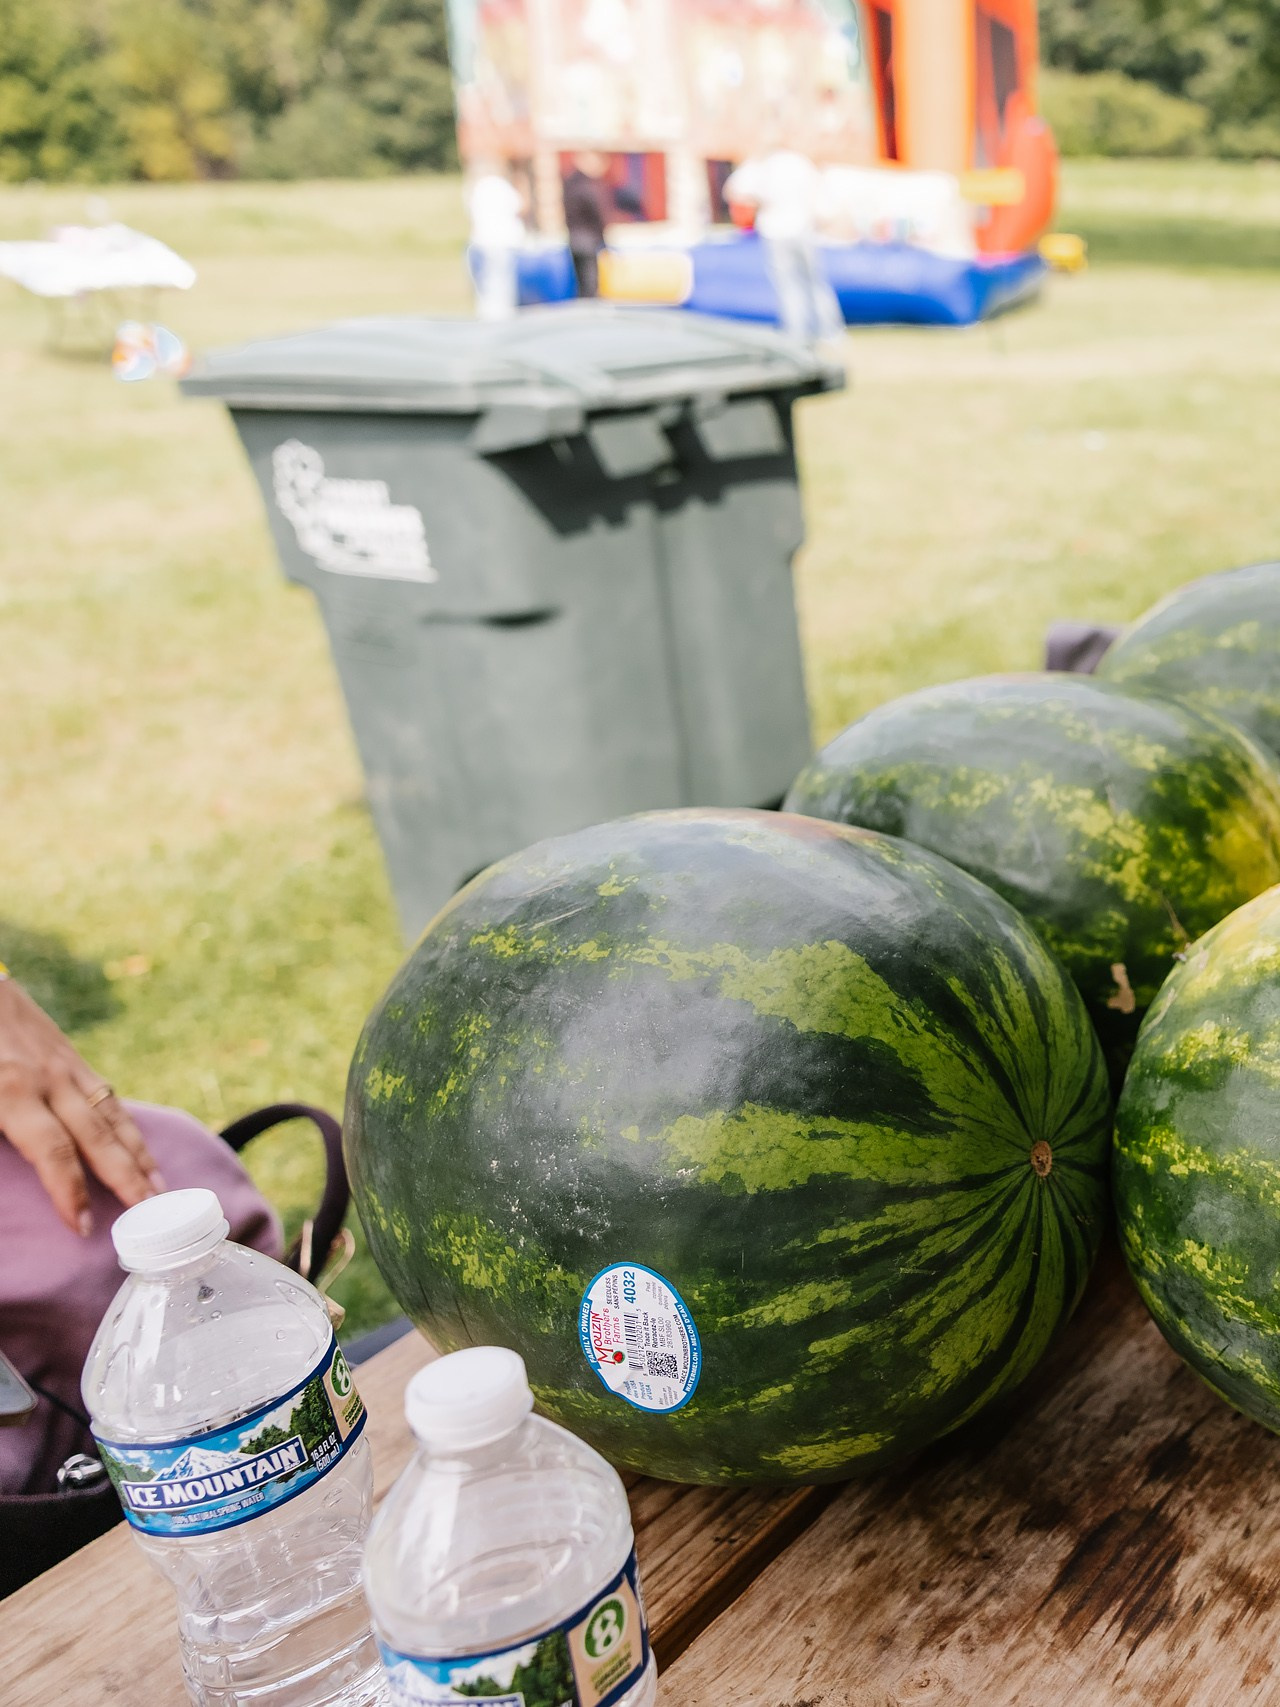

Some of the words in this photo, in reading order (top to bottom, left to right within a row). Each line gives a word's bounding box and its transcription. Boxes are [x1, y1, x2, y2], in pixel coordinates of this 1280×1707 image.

[605, 1277, 613, 1305] SEEDLESS
[623, 1270, 636, 1304] 4032
[581, 1302, 590, 1333] OWNED
[677, 1304, 690, 1323] D'EAU
[590, 1310, 616, 1364] MOUZIN
[613, 1316, 624, 1343] Farms
[650, 1317, 658, 1348] Retracez-le
[658, 1333, 666, 1347] MBF
[687, 1325, 697, 1346] MELON
[581, 1335, 597, 1363] FAMILY
[685, 1352, 698, 1392] WATERMELON
[311, 1445, 324, 1461] 16.9
[322, 1440, 330, 1451] FL
[328, 1432, 337, 1446] OZ
[126, 1485, 161, 1506] ICE
[162, 1446, 300, 1505] MOUNTAIN
[316, 1453, 330, 1472] (500
[219, 1502, 241, 1516] SPRING
[241, 1492, 265, 1508] WATER
